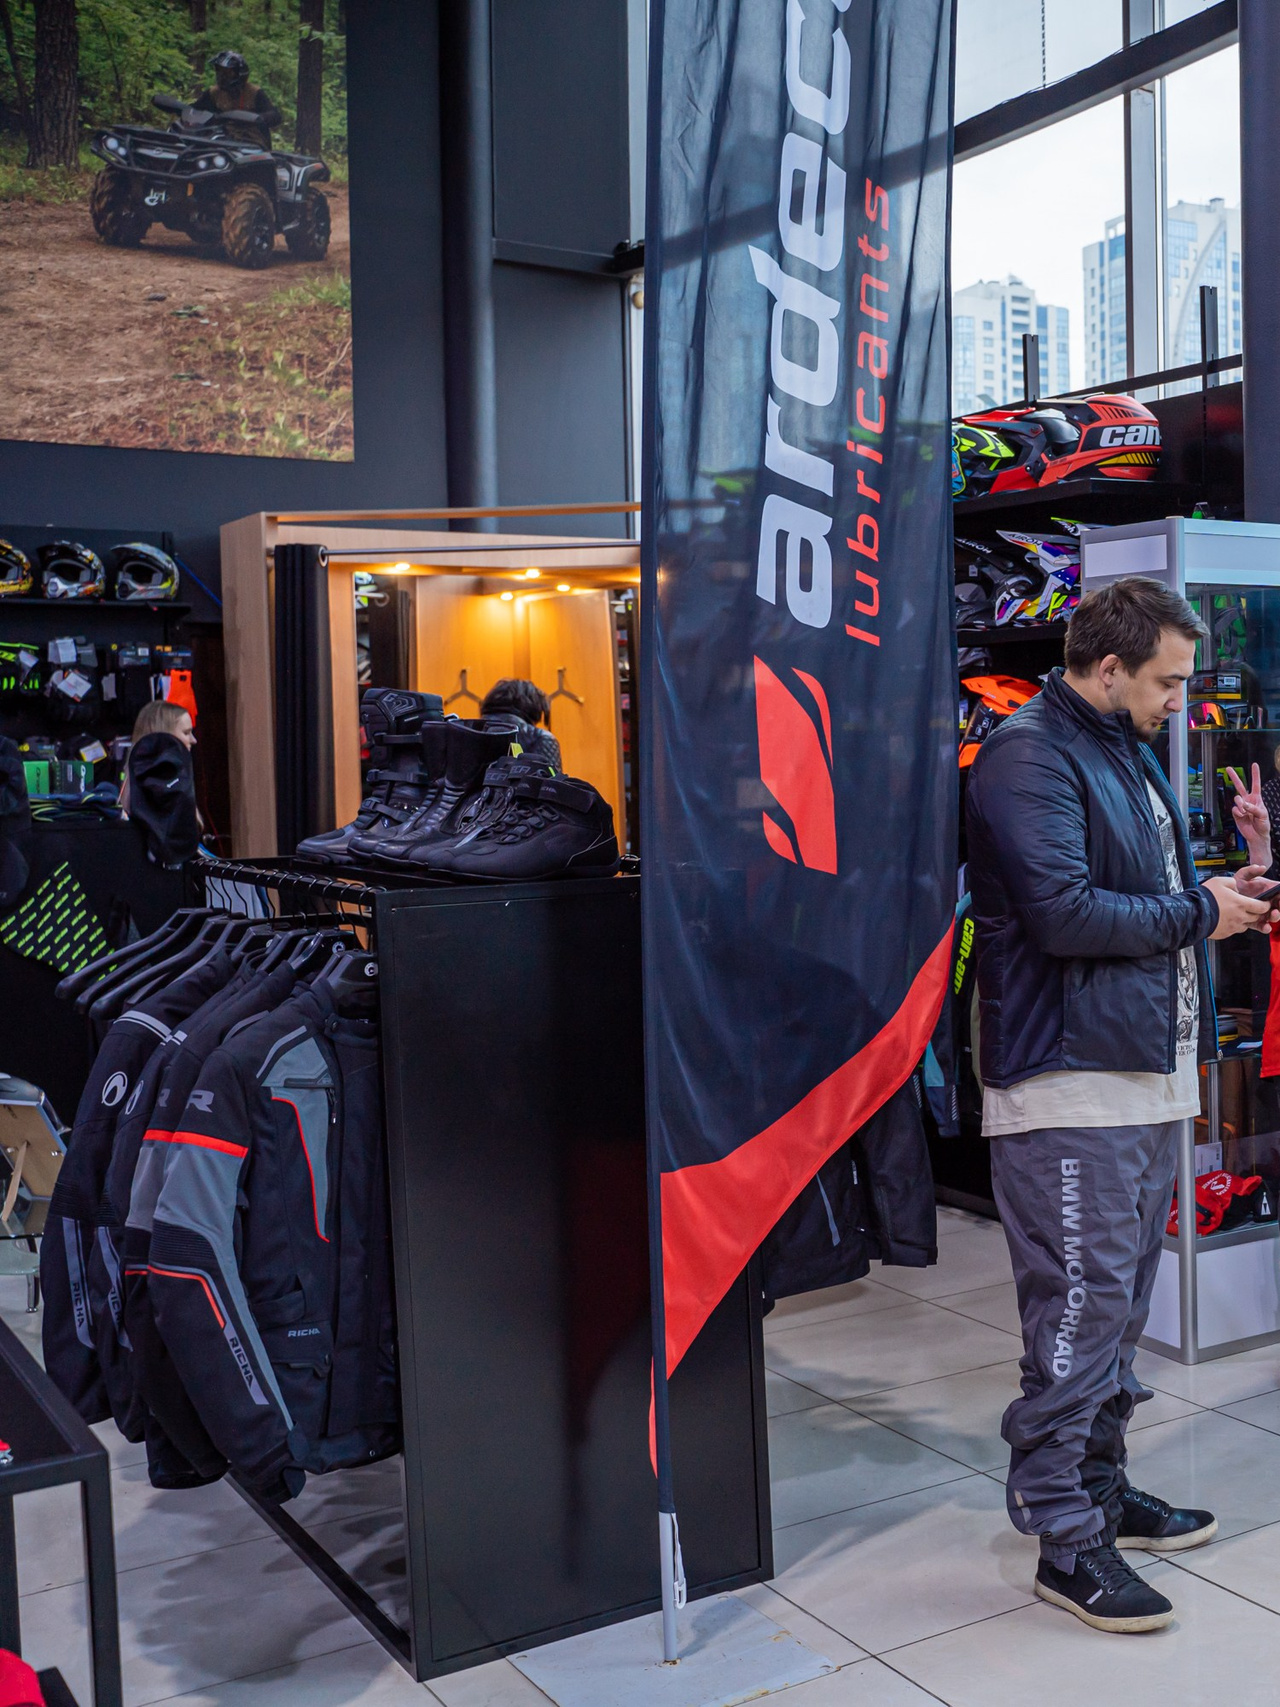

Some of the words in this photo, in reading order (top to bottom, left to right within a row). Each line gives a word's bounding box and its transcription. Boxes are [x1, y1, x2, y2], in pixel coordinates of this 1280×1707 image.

[748, 0, 851, 629] ardec
[845, 177, 890, 647] lubricants
[954, 917, 975, 995] can-am
[1061, 1158, 1082, 1231] BMW
[71, 1282, 85, 1328] RICHA
[287, 1327, 321, 1338] RICHA
[1052, 1236, 1087, 1378] MOORRAD
[229, 1337, 254, 1389] RICHA
